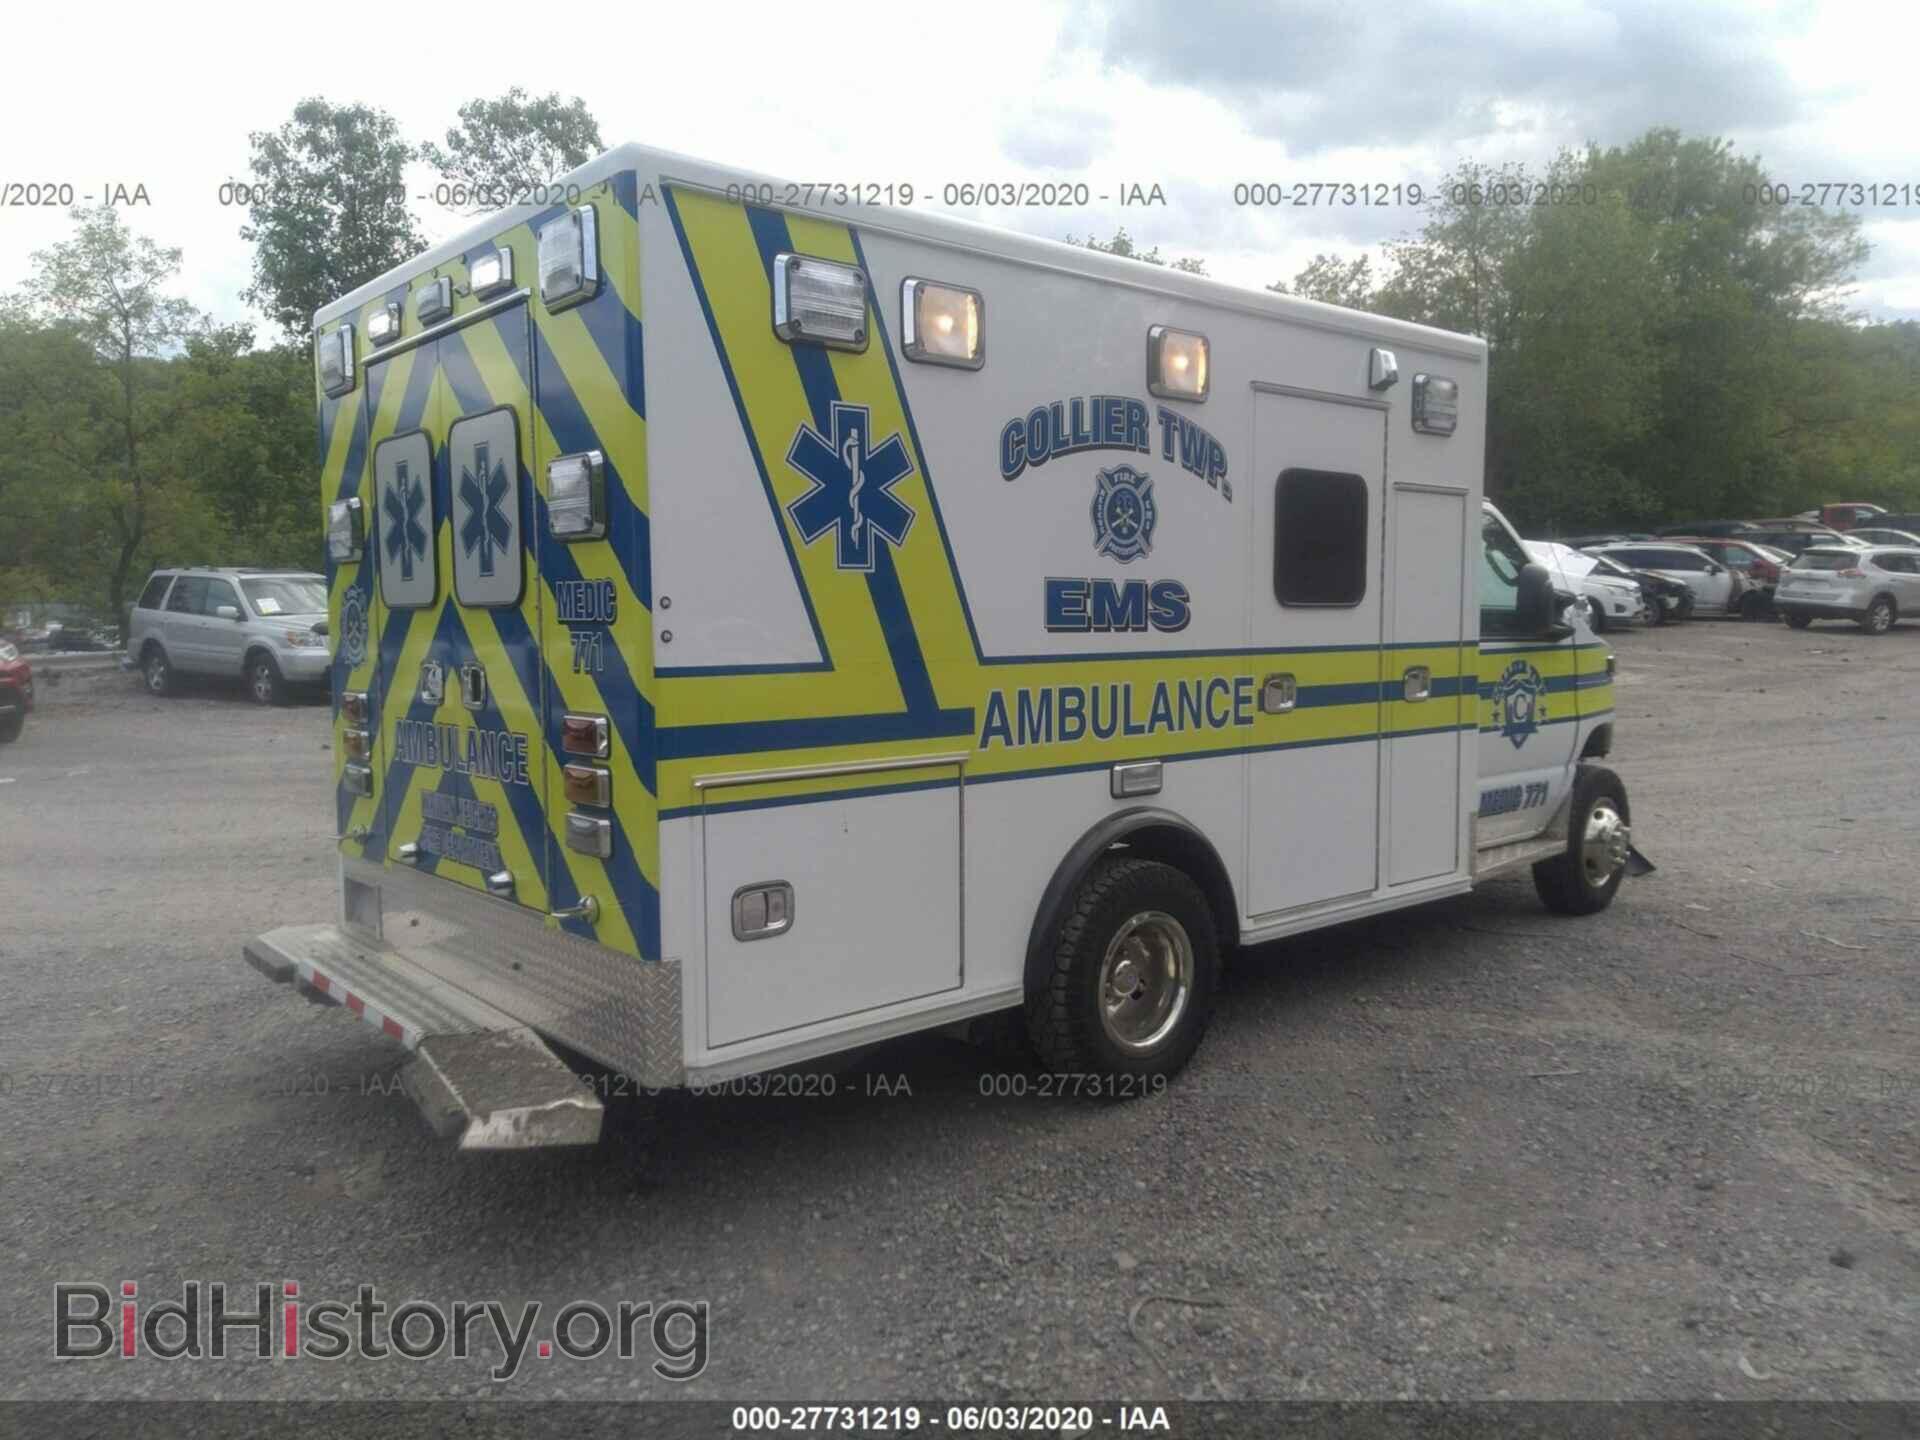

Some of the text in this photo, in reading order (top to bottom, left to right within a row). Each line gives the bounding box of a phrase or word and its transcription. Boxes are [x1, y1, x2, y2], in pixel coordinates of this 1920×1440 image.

[1000, 395, 1233, 504] COLLIER TWP.
[555, 578, 617, 625] MEDIC
[1044, 576, 1191, 633] EMS
[570, 630, 605, 674] 771
[979, 676, 1255, 749] AMBULANCE
[394, 718, 530, 786] AMBULANCE
